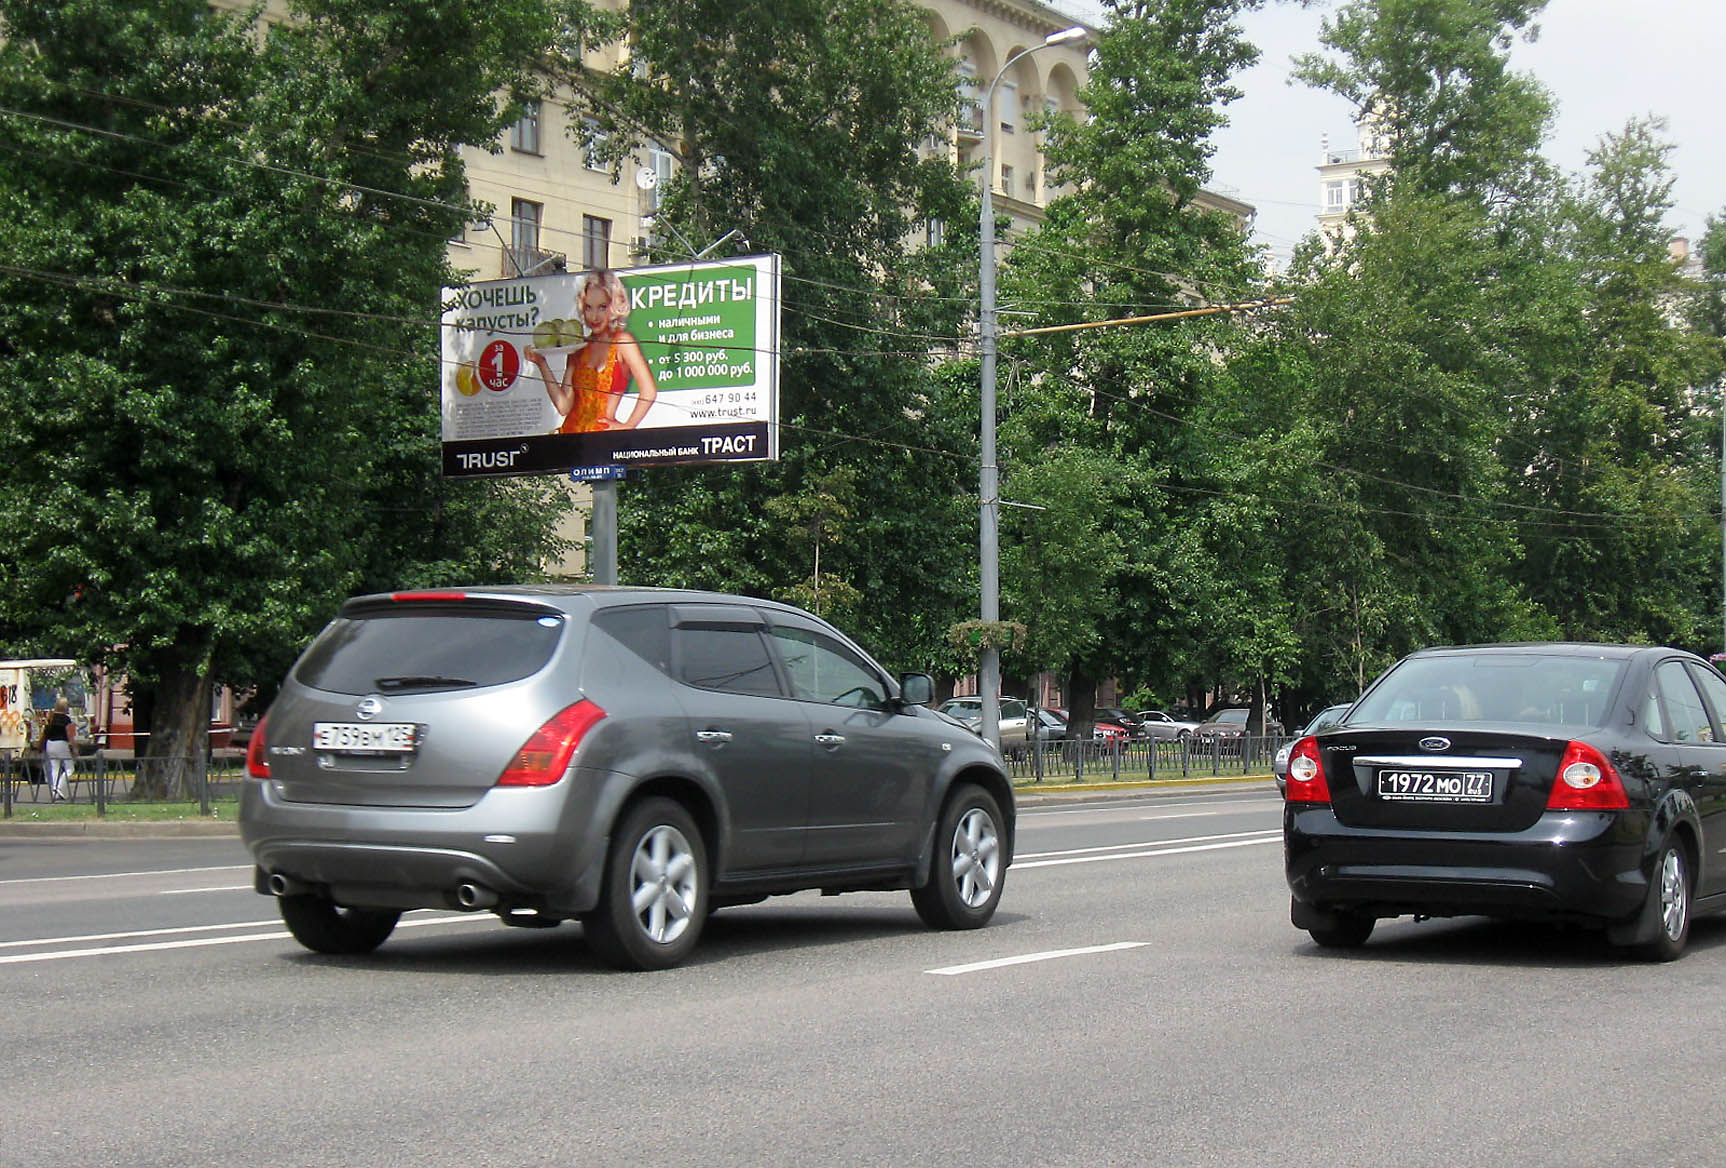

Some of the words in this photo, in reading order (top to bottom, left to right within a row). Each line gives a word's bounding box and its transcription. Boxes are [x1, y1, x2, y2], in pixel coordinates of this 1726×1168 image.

[457, 285, 537, 310] ХОЧЕШЬ
[631, 277, 752, 310] КРЕДИТЫ
[456, 307, 540, 336] капусты?
[658, 315, 721, 329] наличными
[658, 335, 666, 344] и
[668, 332, 689, 344] для
[690, 329, 734, 342] бизнеса
[491, 352, 504, 377] 1
[658, 355, 671, 365] от
[674, 352, 681, 363] 5
[683, 350, 704, 364] 300
[706, 348, 729, 366] руб.
[658, 370, 673, 382] до
[676, 366, 682, 378] 1
[684, 365, 705, 378] 000
[707, 363, 728, 377] 000
[730, 361, 753, 379] руб.
[489, 377, 508, 388] час
[705, 394, 724, 404] 647
[728, 392, 741, 403] 90
[744, 391, 757, 401] 44
[690, 406, 757, 419] www.trust.ru
[612, 446, 677, 460] НАЦИОНАЛЬНЫЙ
[677, 446, 699, 456] БАНК
[701, 435, 757, 455] ТРАСТ
[456, 450, 520, 469] TRUST
